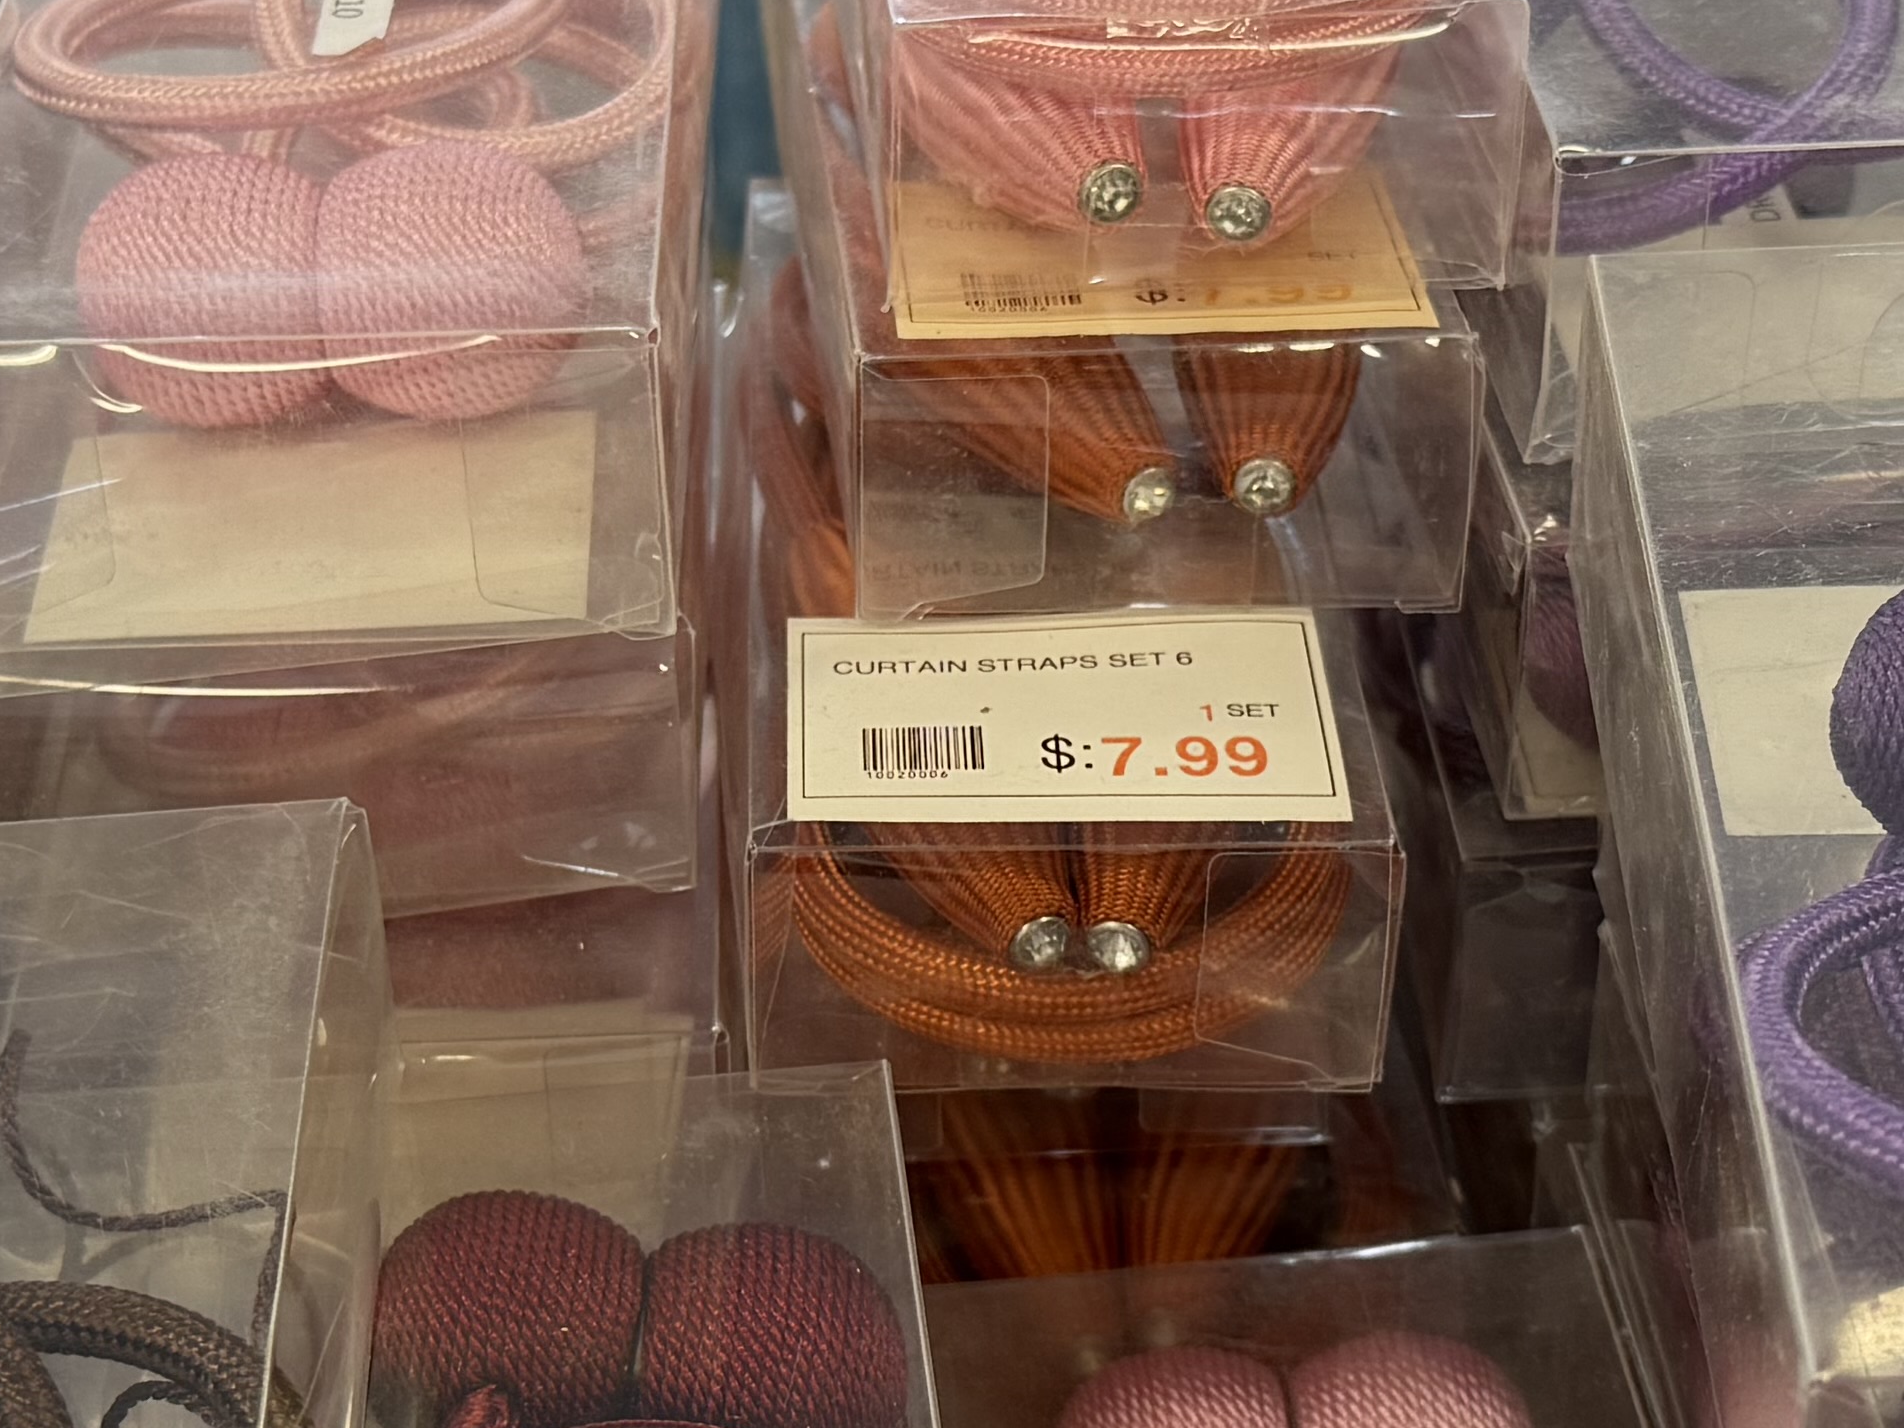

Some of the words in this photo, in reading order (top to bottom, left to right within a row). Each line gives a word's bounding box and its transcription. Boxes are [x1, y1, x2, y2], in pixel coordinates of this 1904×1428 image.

[833, 658, 967, 676] CURTAIN
[977, 654, 1098, 672] STRAPS
[1108, 651, 1166, 669] SET
[1175, 650, 1193, 666] 6
[1199, 704, 1214, 722] 1
[1226, 702, 1280, 719] SET
[1040, 733, 1268, 777] $:7.99
[866, 769, 949, 780] 10020006
